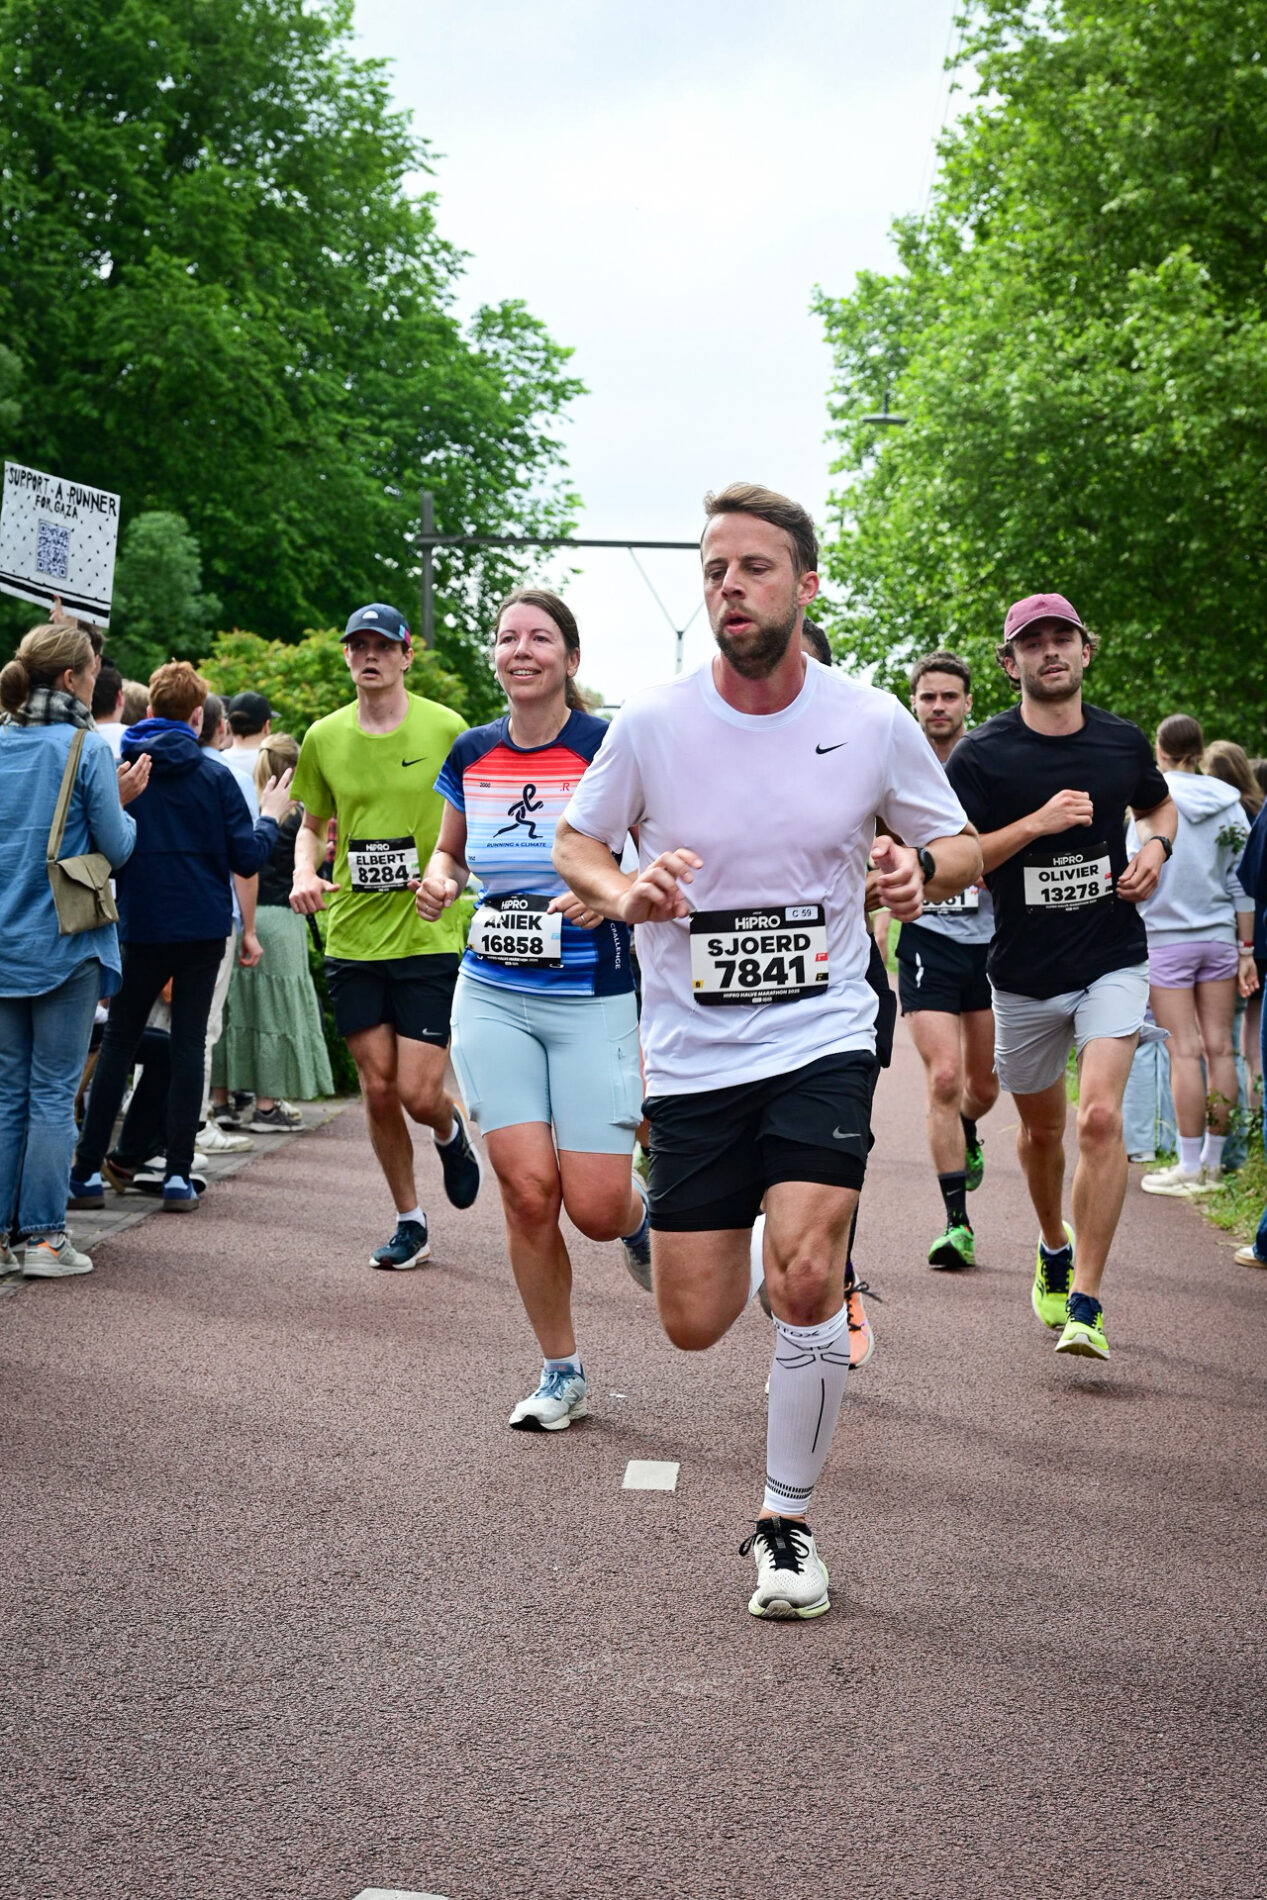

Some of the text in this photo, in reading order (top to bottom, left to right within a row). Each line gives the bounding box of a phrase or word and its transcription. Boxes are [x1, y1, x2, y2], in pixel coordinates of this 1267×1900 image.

[8, 467, 117, 517] SUPPORT A RUNNER
[35, 495, 78, 519] FOR GAZA
[356, 853, 406, 866] ELBERT
[358, 865, 410, 883] 8284
[1038, 864, 1099, 882] OLIVIER
[1041, 881, 1100, 903] 13278
[484, 914, 543, 931] ANIEK
[792, 908, 812, 918] C 59
[481, 934, 544, 955] 16858
[610, 922, 622, 970] CHALLENGE
[707, 933, 811, 957] SJOERD
[714, 955, 806, 989] 7841
